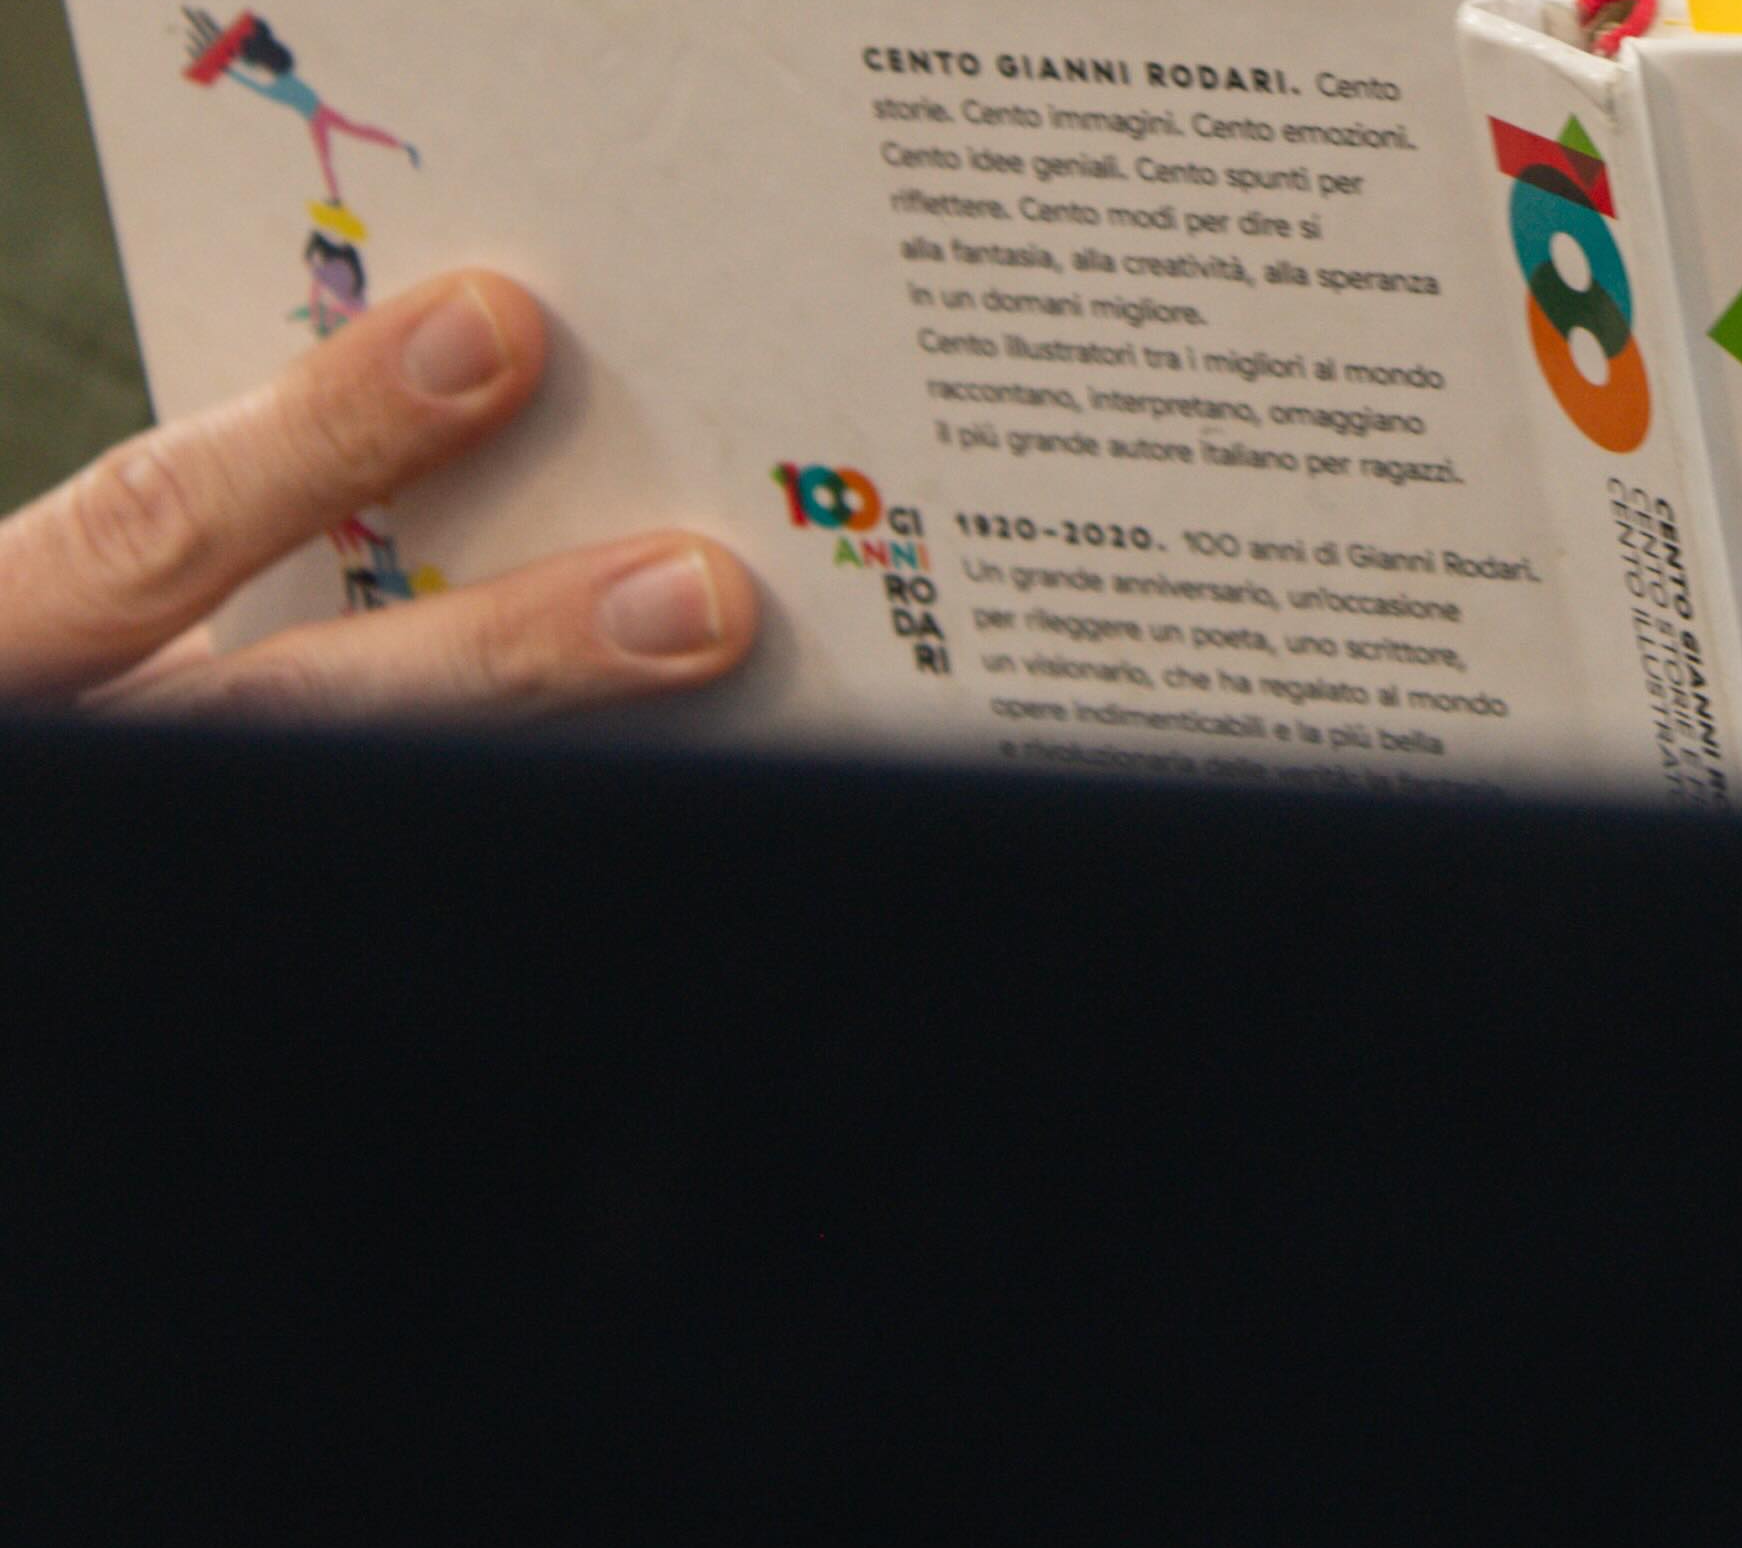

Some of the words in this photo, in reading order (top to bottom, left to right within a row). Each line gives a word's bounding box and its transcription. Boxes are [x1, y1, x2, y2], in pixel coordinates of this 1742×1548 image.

[862, 46, 982, 78] CENTO
[996, 54, 1130, 85] GIANNI
[1145, 61, 1301, 95] RODARI.
[1315, 71, 1402, 101] Cento
[872, 97, 955, 124] storie.
[961, 98, 1043, 129] Cento
[1048, 105, 1185, 141] immagini.
[1190, 112, 1276, 143] Cento
[1280, 122, 1417, 150] emozioni.
[881, 141, 962, 171] Cento
[967, 147, 1026, 175] idee
[1031, 154, 1128, 183] geniali.
[1134, 156, 1219, 187] Cento
[1224, 166, 1312, 193] spunti
[1317, 173, 1365, 198] per
[1018, 195, 1101, 226] Cento
[1106, 205, 1178, 231] modi
[1183, 212, 1230, 237] per
[1237, 211, 1292, 238] dire
[900, 236, 946, 263] alla
[949, 238, 1063, 274] fantasia,
[1071, 247, 1118, 274] alla
[1263, 260, 1311, 287] alla
[1315, 268, 1442, 297] speranza
[908, 283, 935, 305] in
[940, 290, 976, 310] un
[981, 288, 1084, 317] domani
[1089, 297, 1208, 329] migliore.
[917, 327, 1000, 358] Cento
[1003, 334, 1137, 366] illustratori
[1142, 346, 1184, 371] tra
[1202, 350, 1307, 383] migliori
[1313, 357, 1338, 382] al
[1343, 364, 1446, 390] mondo
[926, 379, 1083, 414] raccontano,
[1088, 387, 1262, 427] interpretano,
[1268, 404, 1427, 438] omaggiano
[935, 420, 953, 445] il
[957, 424, 1001, 451] più
[1006, 430, 1101, 458] grande
[1107, 438, 1195, 464] autore
[1199, 440, 1300, 472] italiano
[1304, 453, 1352, 478] per
[1359, 458, 1465, 487] ragazzi.
[769, 461, 883, 532] 100
[887, 505, 925, 537] GI
[833, 535, 932, 572] ANNI
[954, 512, 1166, 552] 1920-2020.
[1181, 530, 1242, 559] 100
[1248, 540, 1308, 563] anni
[1312, 541, 1341, 567] di
[1346, 543, 1437, 574] Gianni
[1441, 550, 1542, 583] Rodari.
[1607, 476, 1646, 599] CENTO
[882, 572, 938, 606] RO
[962, 560, 1005, 583] Un
[1009, 566, 1105, 593] grande
[890, 606, 945, 641] DA
[972, 607, 1017, 631] per
[1148, 624, 1185, 644] un
[1190, 626, 1274, 658] poeta,
[1284, 637, 1339, 658] uno
[1344, 638, 1467, 673] scrittore,
[1630, 487, 1669, 608] CENTO
[1655, 617, 1696, 740] STORIE
[1654, 497, 1694, 621] CENTO
[1680, 629, 1722, 760] GIANNI
[913, 642, 953, 676] RI
[981, 654, 1017, 674] un
[1162, 666, 1212, 691] che
[1217, 669, 1254, 695] ha
[1258, 677, 1370, 706] regalato
[1377, 685, 1401, 708] al
[1406, 690, 1509, 717] mondo
